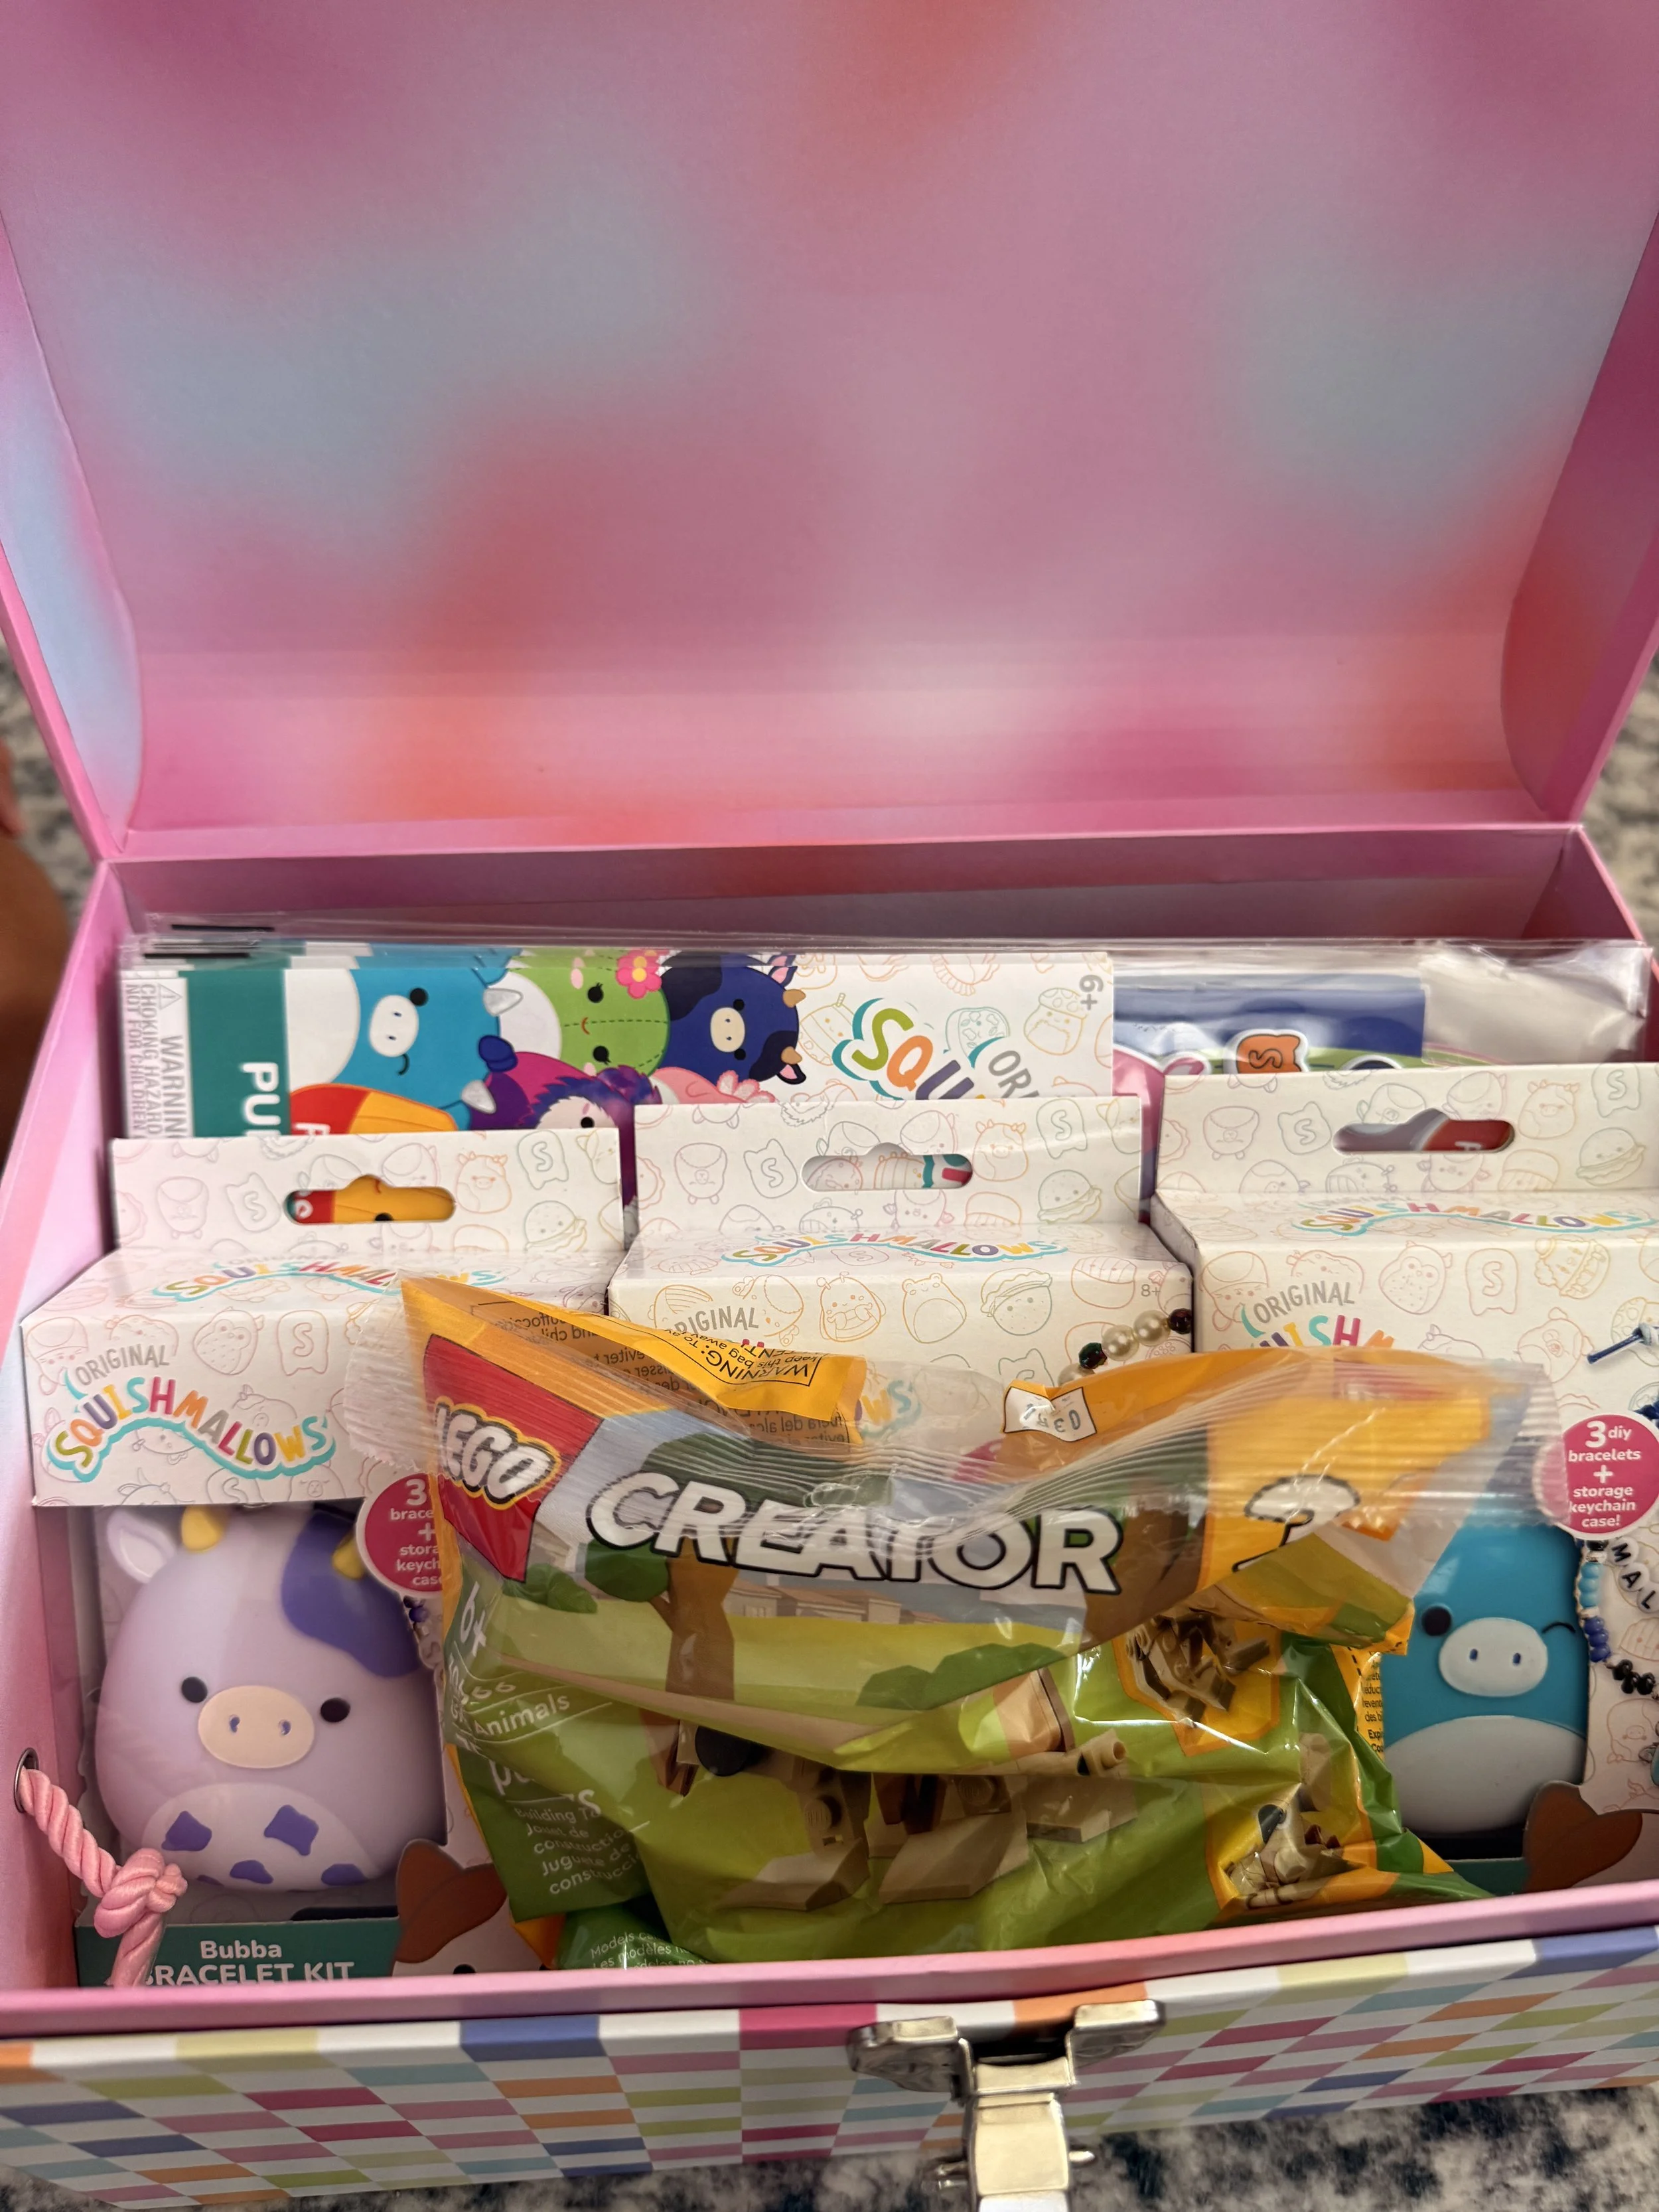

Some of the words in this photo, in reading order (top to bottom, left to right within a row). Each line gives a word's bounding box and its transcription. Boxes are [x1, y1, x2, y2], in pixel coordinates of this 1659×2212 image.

[1079, 974, 1104, 1011] 6+
[161, 1035, 186, 1138] WARNIN
[240, 1062, 282, 1136] PU
[1300, 1202, 1640, 1231] SQUISHMALLOWS
[731, 1232, 1058, 1262] SQUISHMALLOWS
[1141, 1284, 1161, 1297] 8+
[1254, 1281, 1355, 1325] ORIGINAL
[674, 1305, 759, 1334] RIGINAL
[75, 1343, 170, 1386] ORIGINAL
[700, 1345, 809, 1382] WARNING:
[728, 1347, 755, 1370] bag
[55, 1376, 327, 1469] SQUISHMALLOWS
[1585, 1420, 1607, 1448] 3
[1607, 1426, 1632, 1441] diy
[435, 1400, 557, 1505] LEGO
[1567, 1449, 1642, 1463] bracelets
[406, 1478, 427, 1507] 3
[1568, 1499, 1636, 1514] keychain
[1573, 1485, 1634, 1499] storage
[586, 1465, 1126, 1595] CREATOR
[1581, 1514, 1621, 1528] case!
[473, 1692, 571, 1737] Animals
[514, 1806, 577, 1824] Building
[569, 1826, 589, 1839] de
[541, 1855, 606, 1877] Juguete
[200, 1939, 283, 1960] Bubba
[591, 1931, 636, 1959] Models
[304, 1961, 355, 1982] KIT
